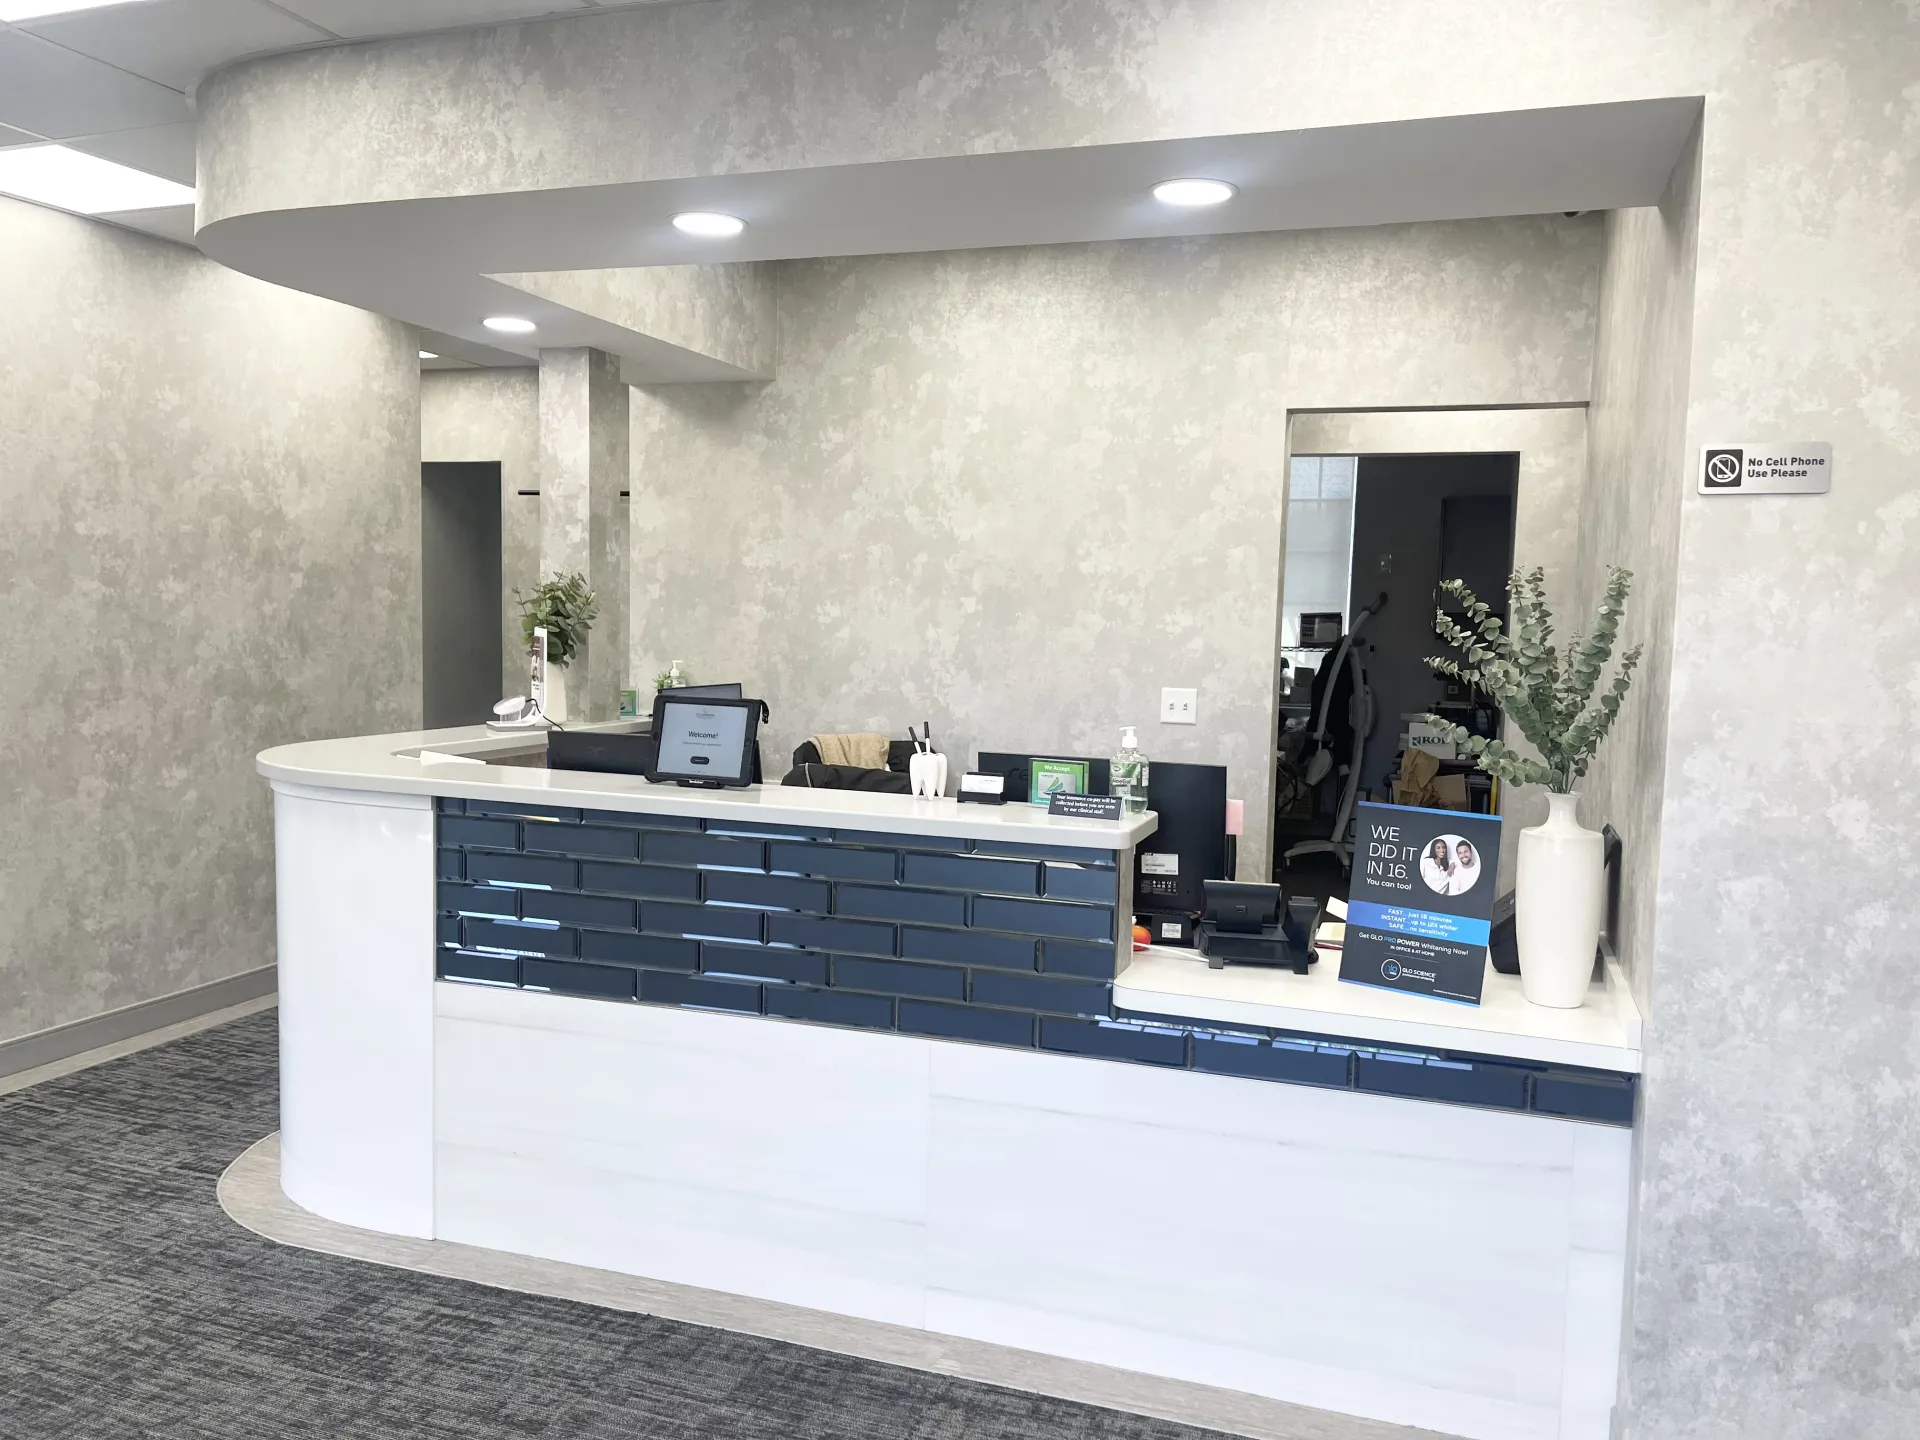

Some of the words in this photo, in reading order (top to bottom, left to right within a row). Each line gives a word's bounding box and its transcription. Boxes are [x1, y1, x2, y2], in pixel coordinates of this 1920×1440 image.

[1747, 457, 1763, 467] No
[1766, 457, 1788, 466] Cell
[1790, 457, 1825, 466] Phone
[1747, 469, 1768, 478] Use
[1770, 468, 1808, 478] Please
[688, 731, 718, 739] Welcome!
[1053, 765, 1071, 773] Accept
[1371, 824, 1400, 841] WE
[1369, 843, 1397, 859] DID
[1402, 847, 1418, 862] IT
[1367, 860, 1383, 876] IN
[1387, 863, 1408, 880] 16.
[1366, 877, 1380, 886] You
[1381, 880, 1396, 889] can
[1396, 881, 1412, 891] too!
[1418, 927, 1449, 938] sensitivity
[1358, 931, 1370, 940] Get
[1370, 934, 1383, 942] GLO
[1383, 936, 1397, 944] PRO
[1396, 938, 1421, 948] POWER
[1420, 941, 1451, 955] Whitening
[1452, 947, 1470, 957] Now!
[1413, 969, 1436, 978] SCIENCE
